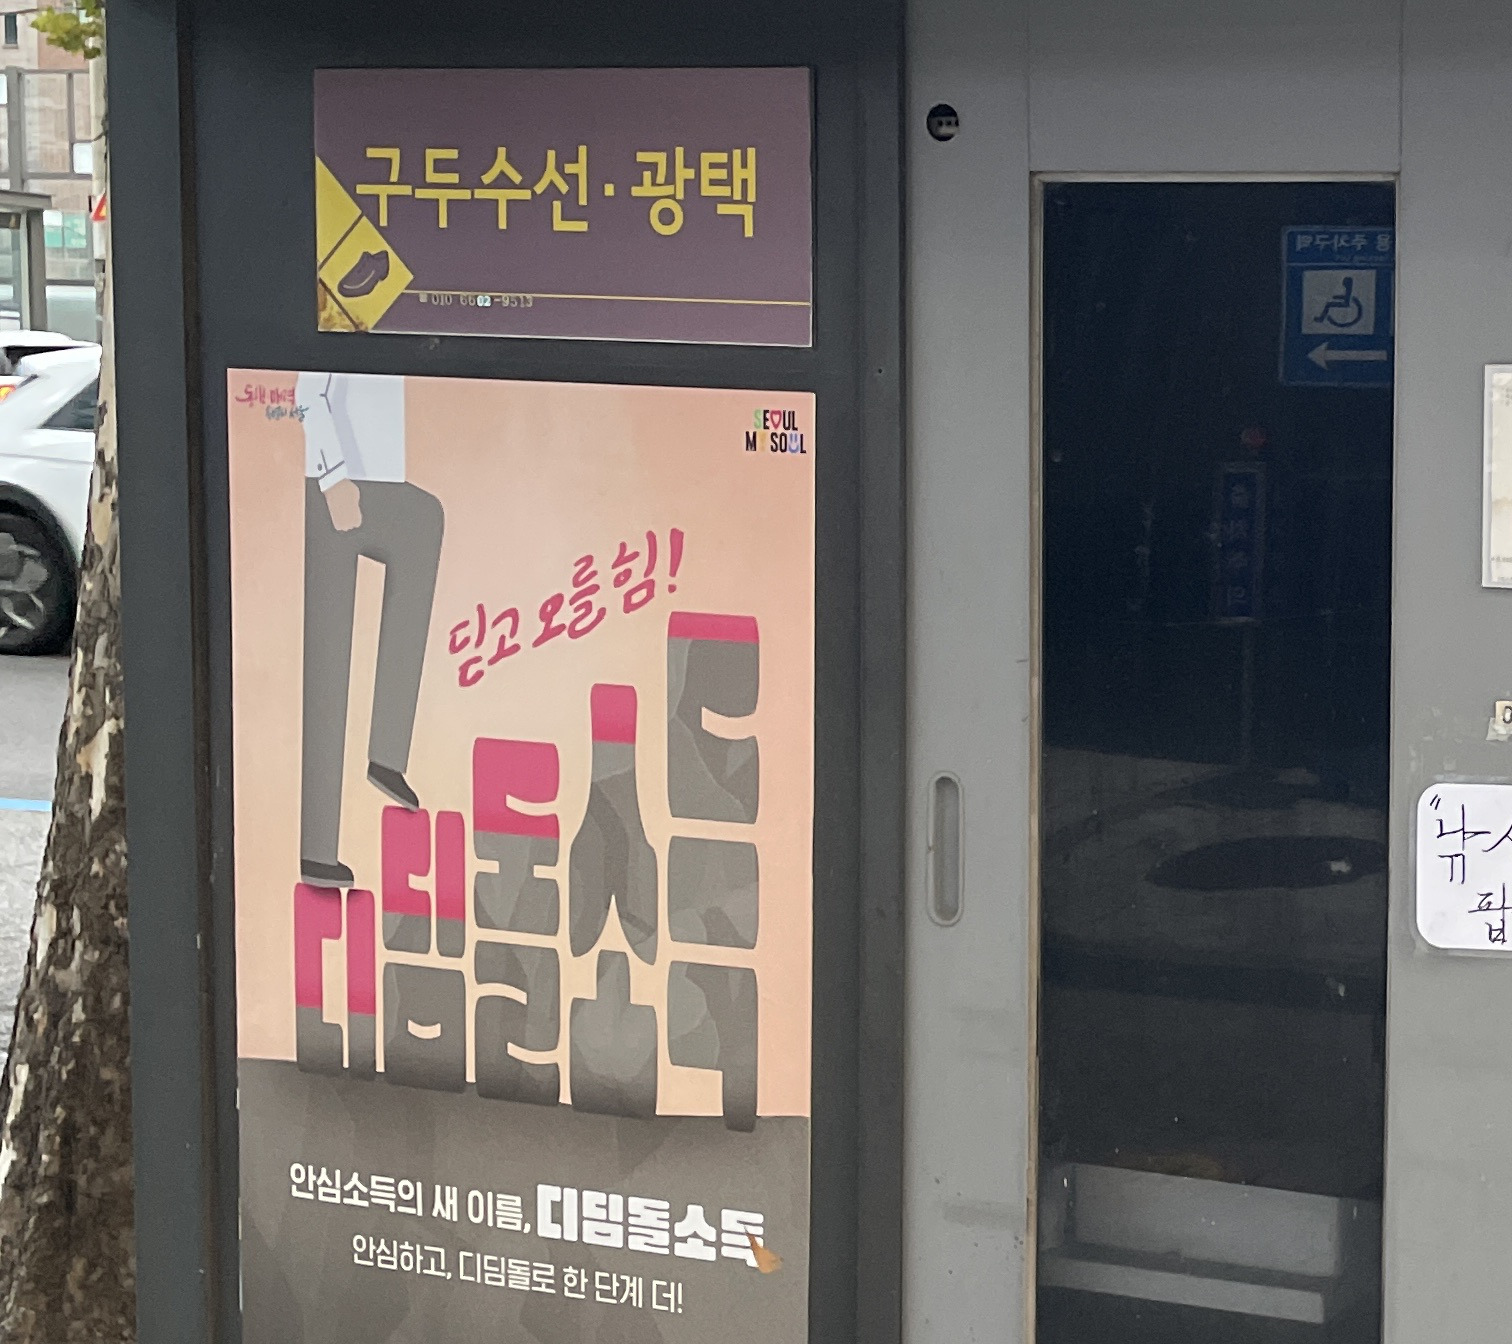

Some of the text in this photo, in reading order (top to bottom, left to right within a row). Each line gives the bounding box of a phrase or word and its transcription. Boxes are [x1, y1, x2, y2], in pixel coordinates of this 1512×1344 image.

[745, 430, 807, 454] MY SOUL
[448, 528, 685, 687] 딛고 오를 힘!
[294, 611, 760, 1133] 디딤돌소득
[289, 1162, 765, 1269] 안심소득의 새 이름, 디딤돌소득
[352, 1234, 683, 1314] 안심하고, 디딤돌로 한 단계 더!
